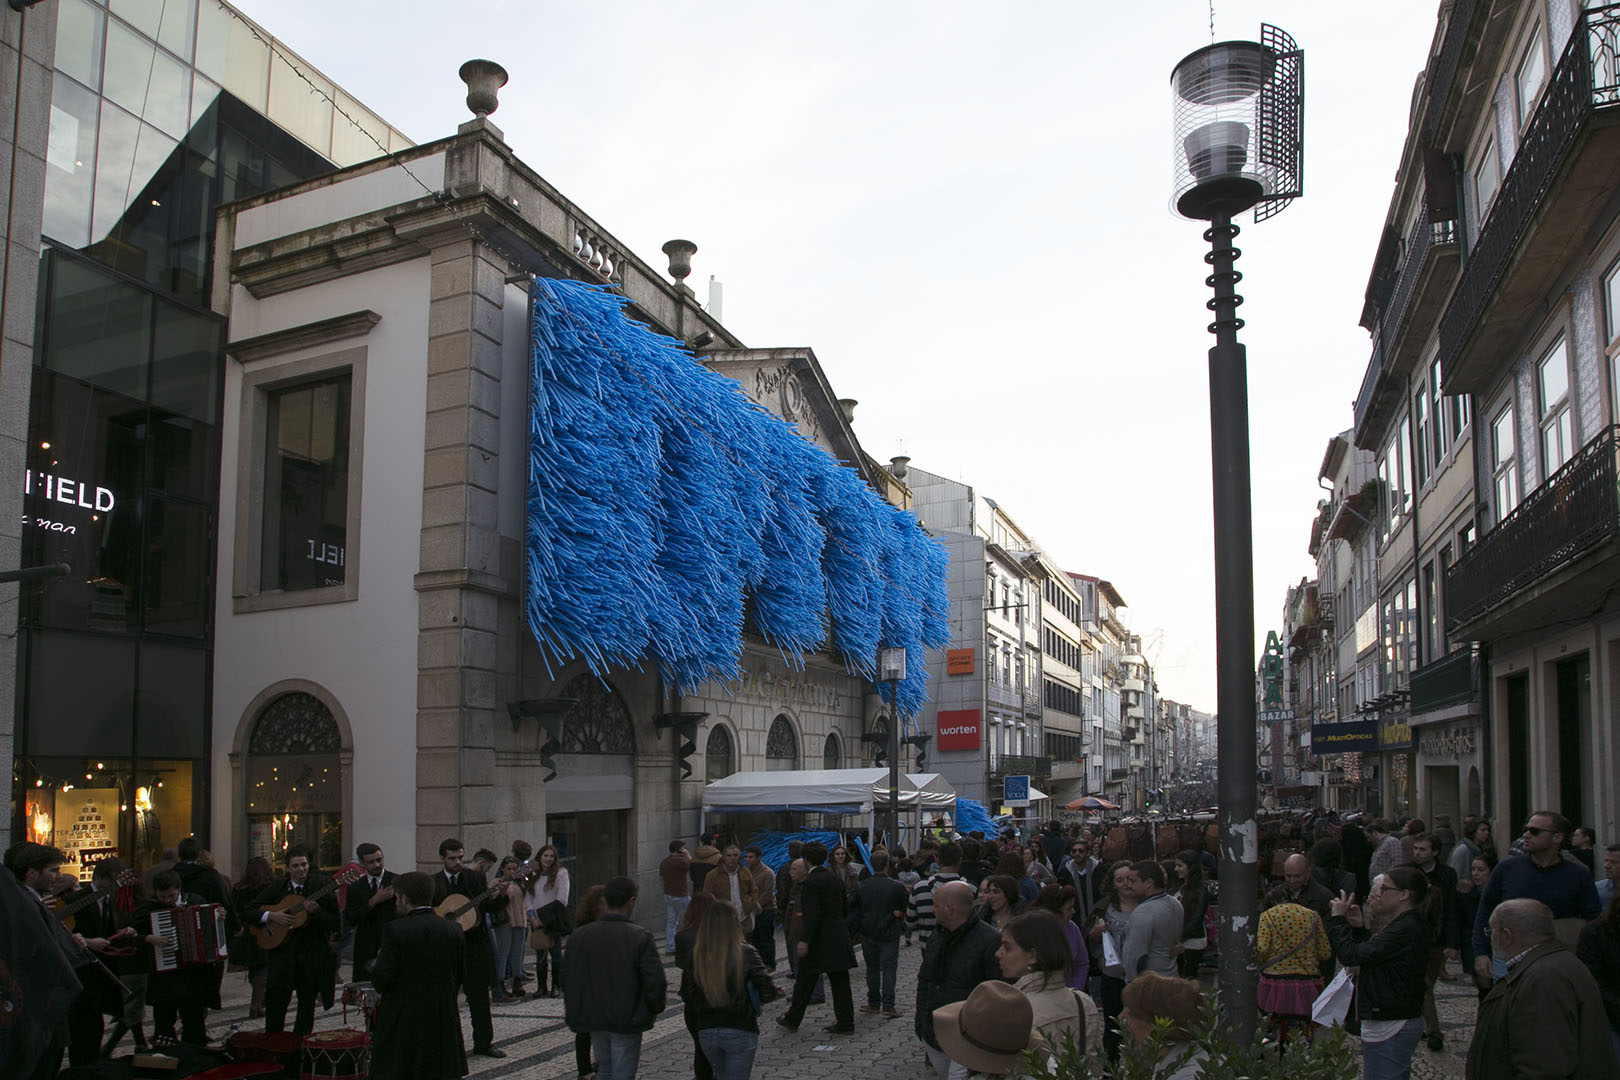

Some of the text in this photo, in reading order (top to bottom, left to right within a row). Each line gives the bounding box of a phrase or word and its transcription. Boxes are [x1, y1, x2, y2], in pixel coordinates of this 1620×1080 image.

[1260, 710, 1295, 721] BAZAR
[940, 725, 976, 736] worten
[1007, 791, 1026, 799] YOGA
